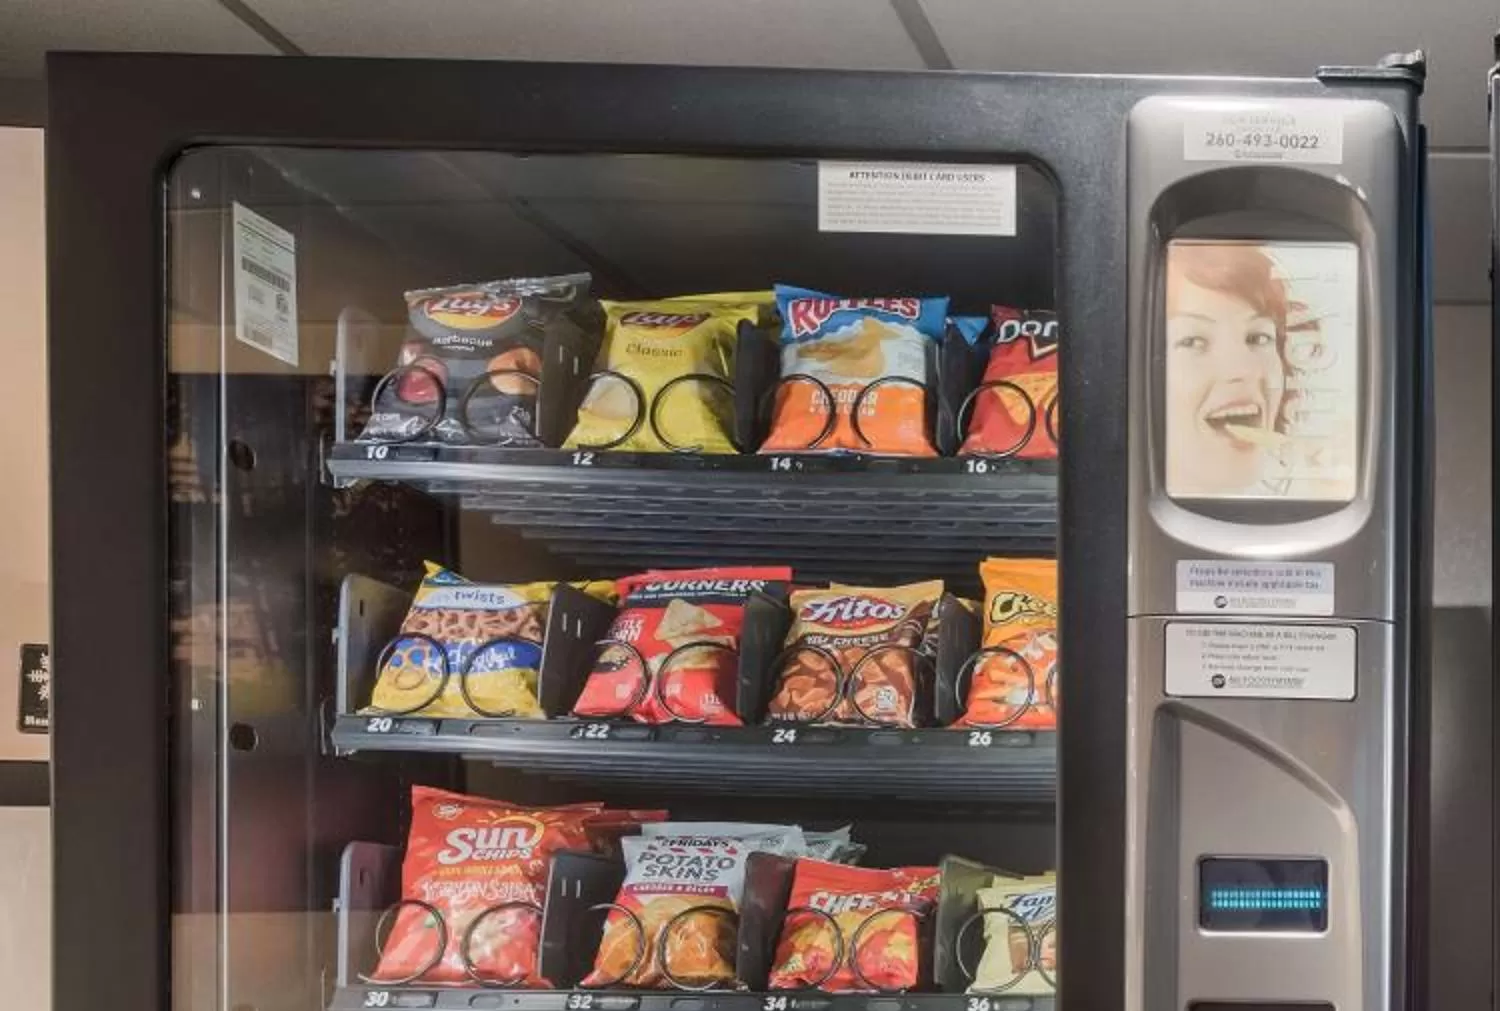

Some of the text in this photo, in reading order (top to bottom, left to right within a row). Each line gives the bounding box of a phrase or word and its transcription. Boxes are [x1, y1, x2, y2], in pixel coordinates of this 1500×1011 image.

[1205, 132, 1320, 149] 260-493-0022
[366, 446, 389, 459] 10
[571, 451, 594, 465] 12
[769, 456, 791, 471] 14
[966, 459, 988, 474] 16
[801, 594, 906, 624] Fritos
[366, 717, 393, 733] 20
[586, 724, 610, 739] 22
[772, 729, 797, 744] 24
[968, 731, 993, 746] 26
[437, 827, 530, 865] Sun
[637, 850, 737, 870] POTATO
[641, 863, 720, 881] SKINS
[364, 991, 389, 1007] 30
[569, 993, 593, 1009] 32
[763, 996, 788, 1011] 34
